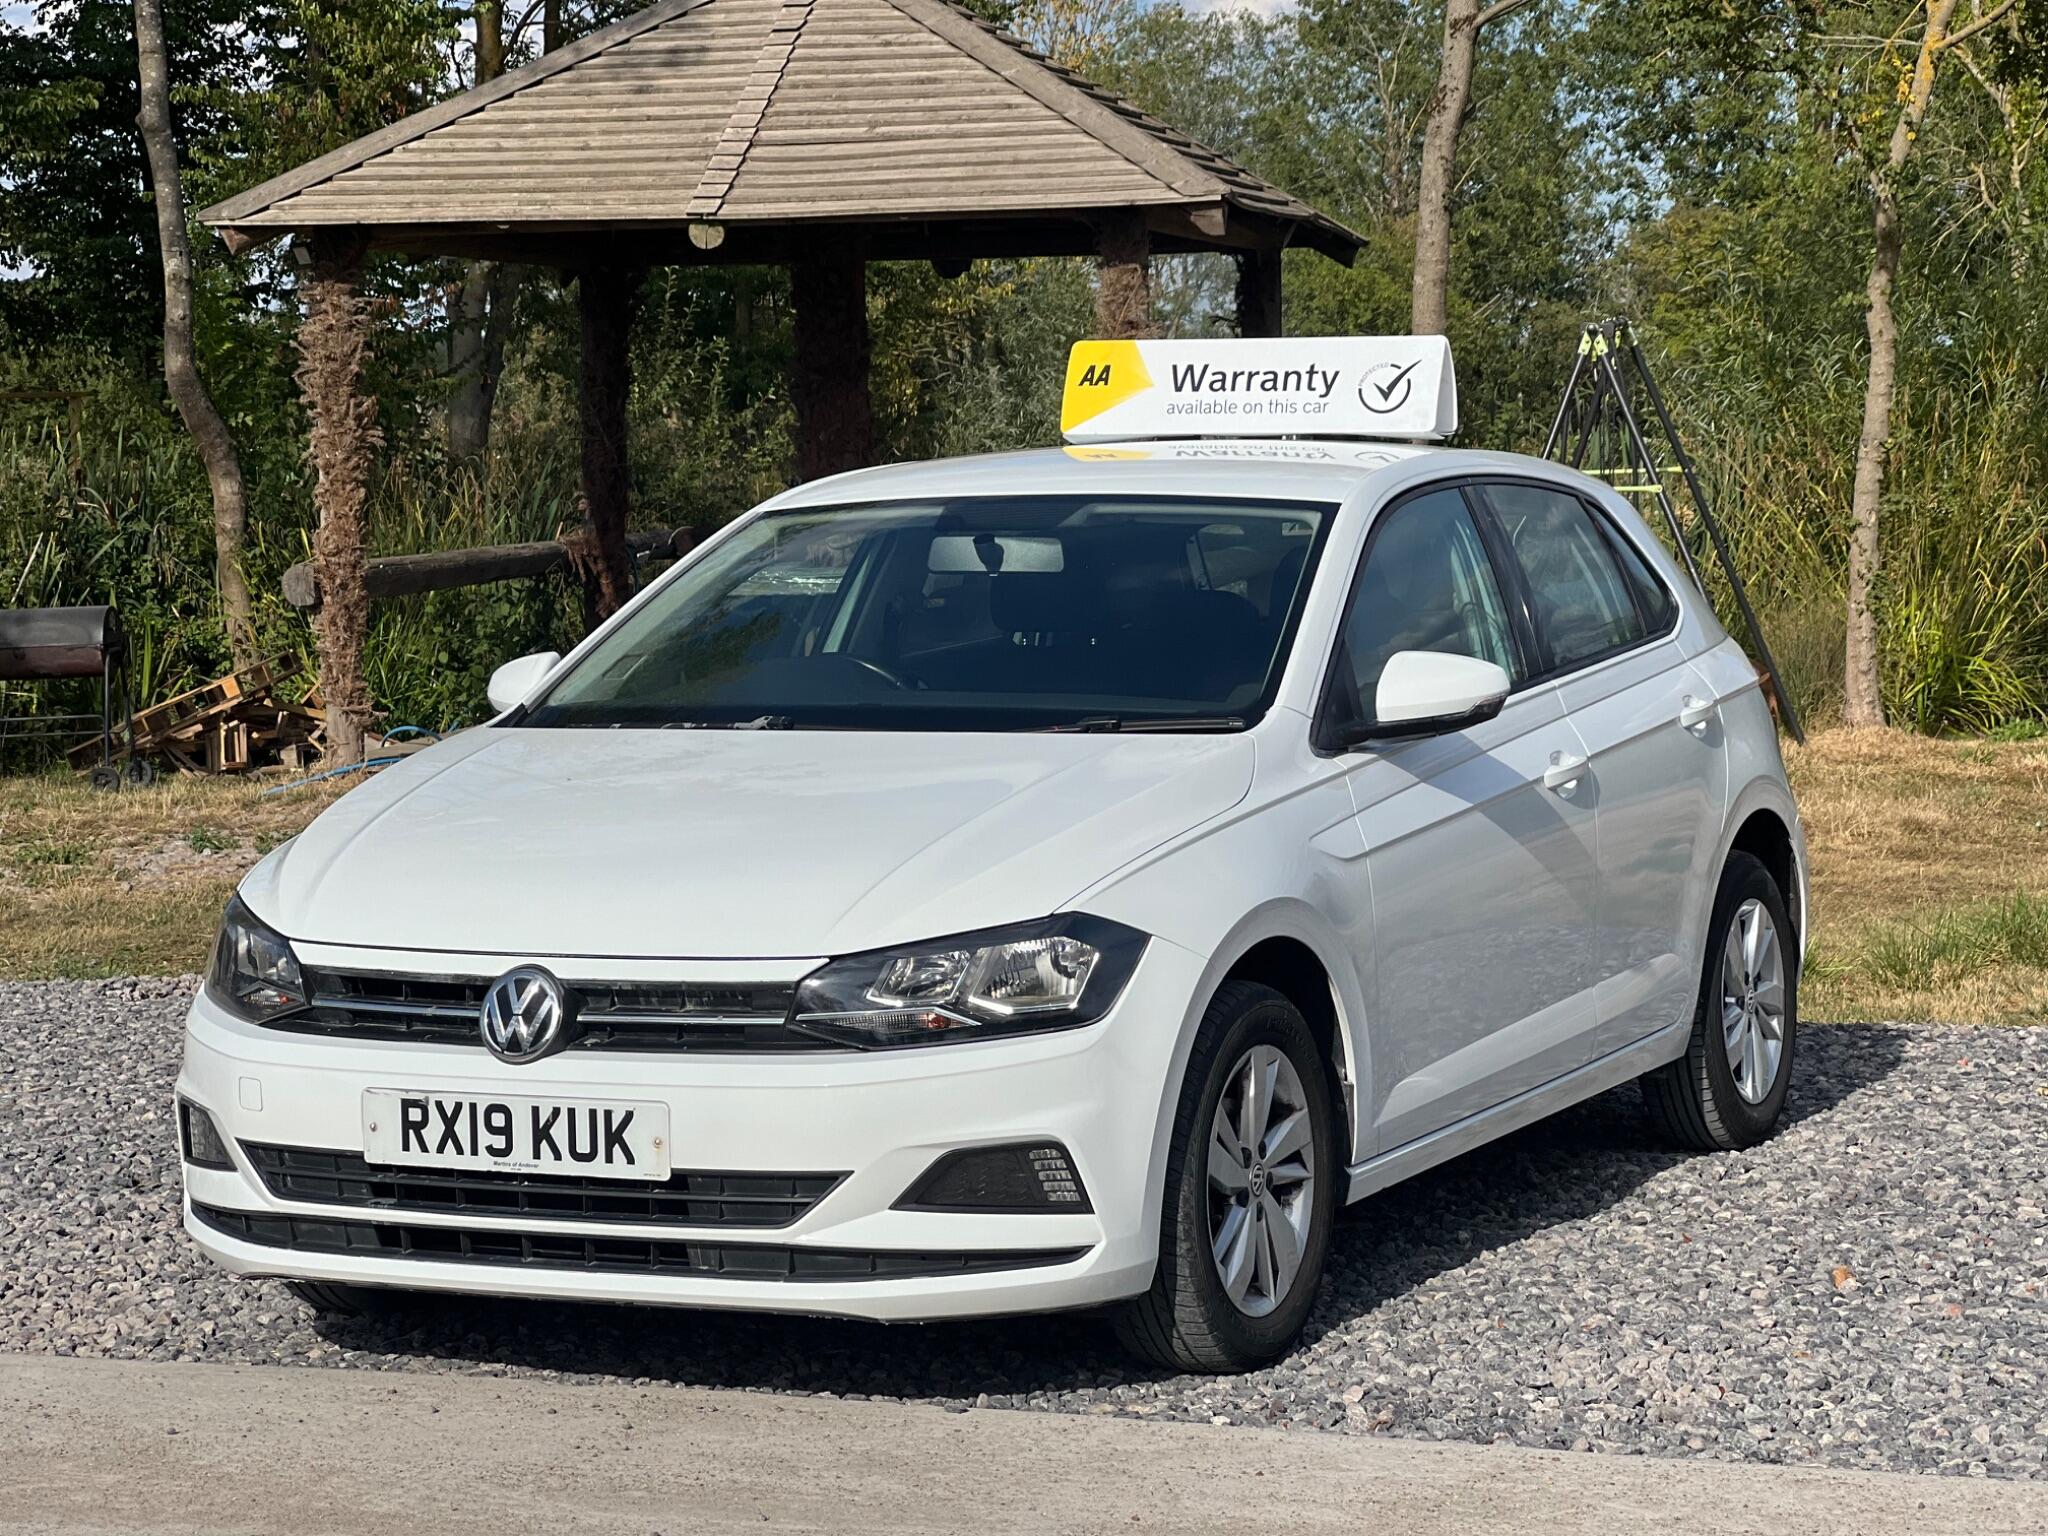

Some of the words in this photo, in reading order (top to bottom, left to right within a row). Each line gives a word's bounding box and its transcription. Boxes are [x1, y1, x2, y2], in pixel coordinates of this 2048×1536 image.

[1078, 364, 1111, 386] AA
[1172, 363, 1340, 398] Warranty
[1166, 400, 1237, 414] available
[1242, 403, 1263, 414] on
[1269, 399, 1297, 414] this
[1302, 401, 1329, 414] car
[400, 1097, 514, 1158] RX19
[531, 1104, 636, 1166] KUK
